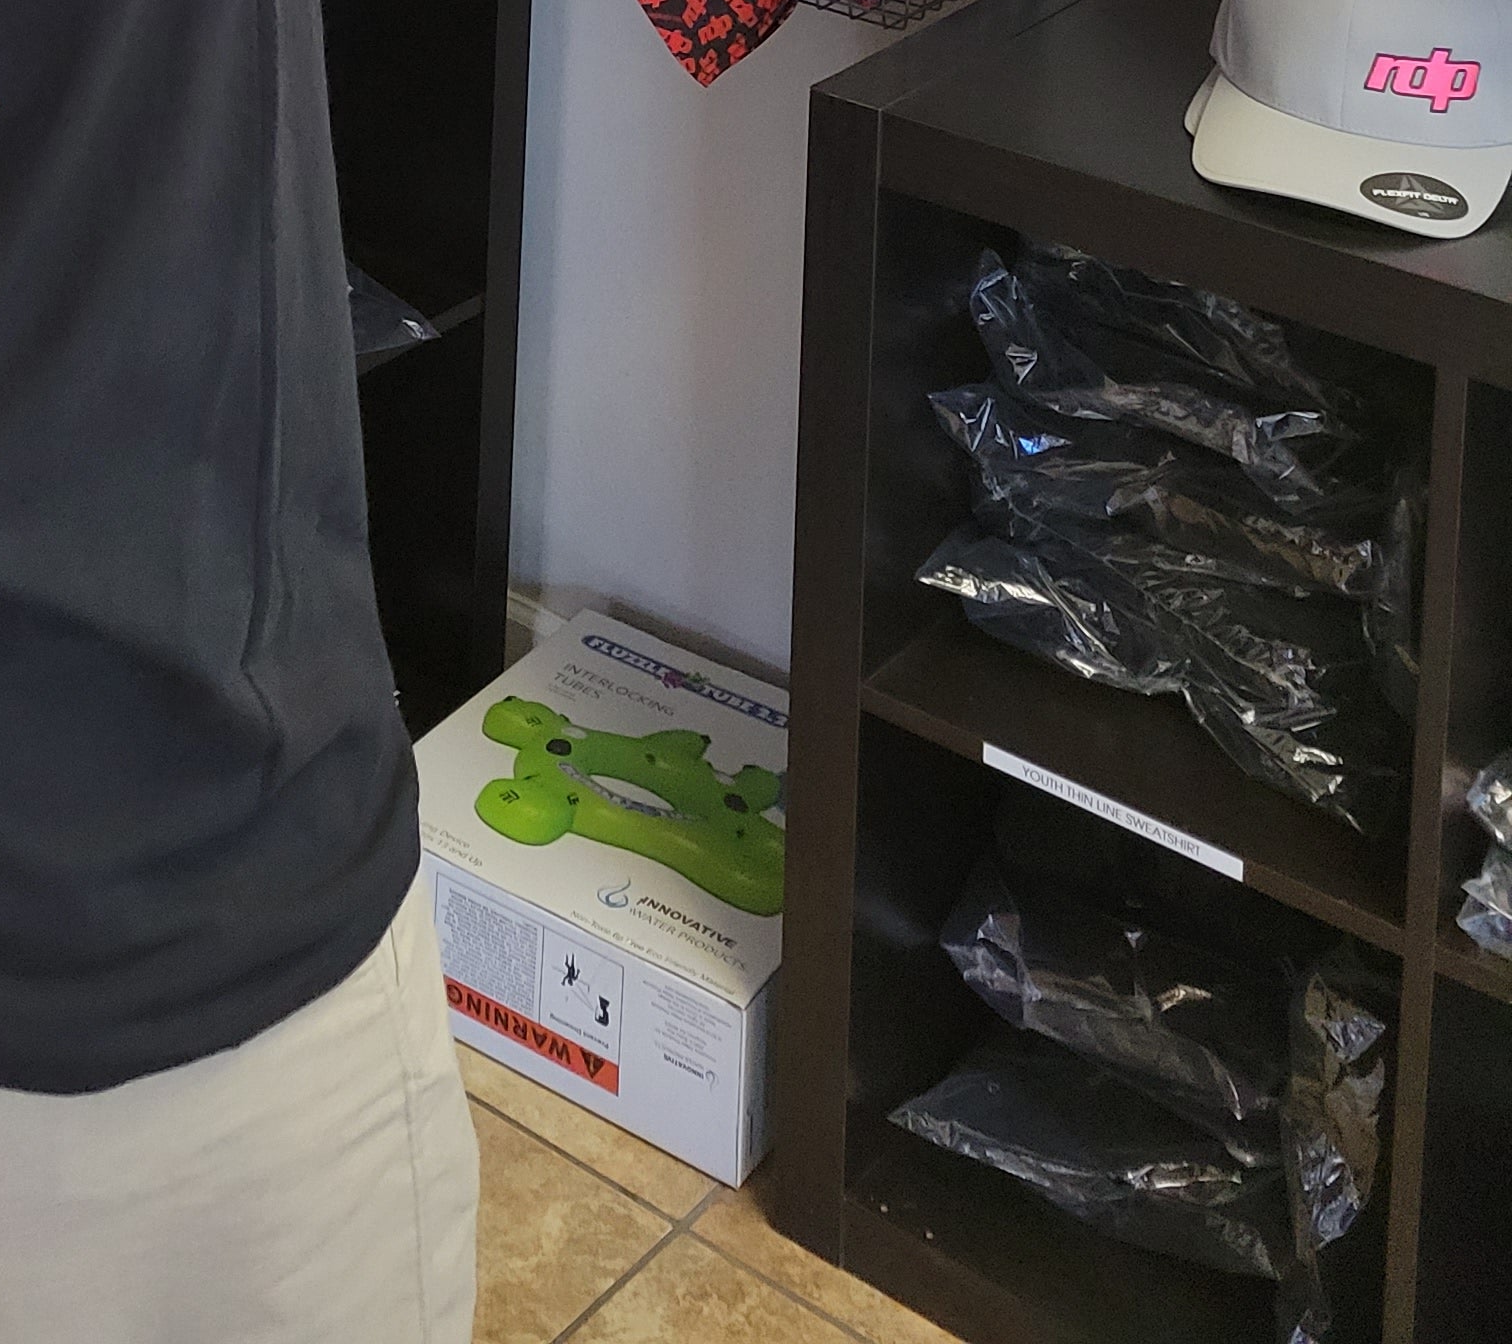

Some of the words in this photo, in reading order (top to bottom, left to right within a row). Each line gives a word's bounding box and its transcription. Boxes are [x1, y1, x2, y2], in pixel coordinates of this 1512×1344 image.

[1364, 47, 1481, 113] rdp
[554, 671, 602, 701] TUBES
[563, 662, 675, 717] INTERLOCKING
[1022, 765, 1064, 793] YOUTH
[1067, 785, 1094, 807] THIN
[1096, 798, 1123, 820] LINE
[1125, 813, 1201, 857] SWEATSHIRT
[636, 895, 738, 949] INNOVATIVE
[446, 984, 572, 1066] WARNING
